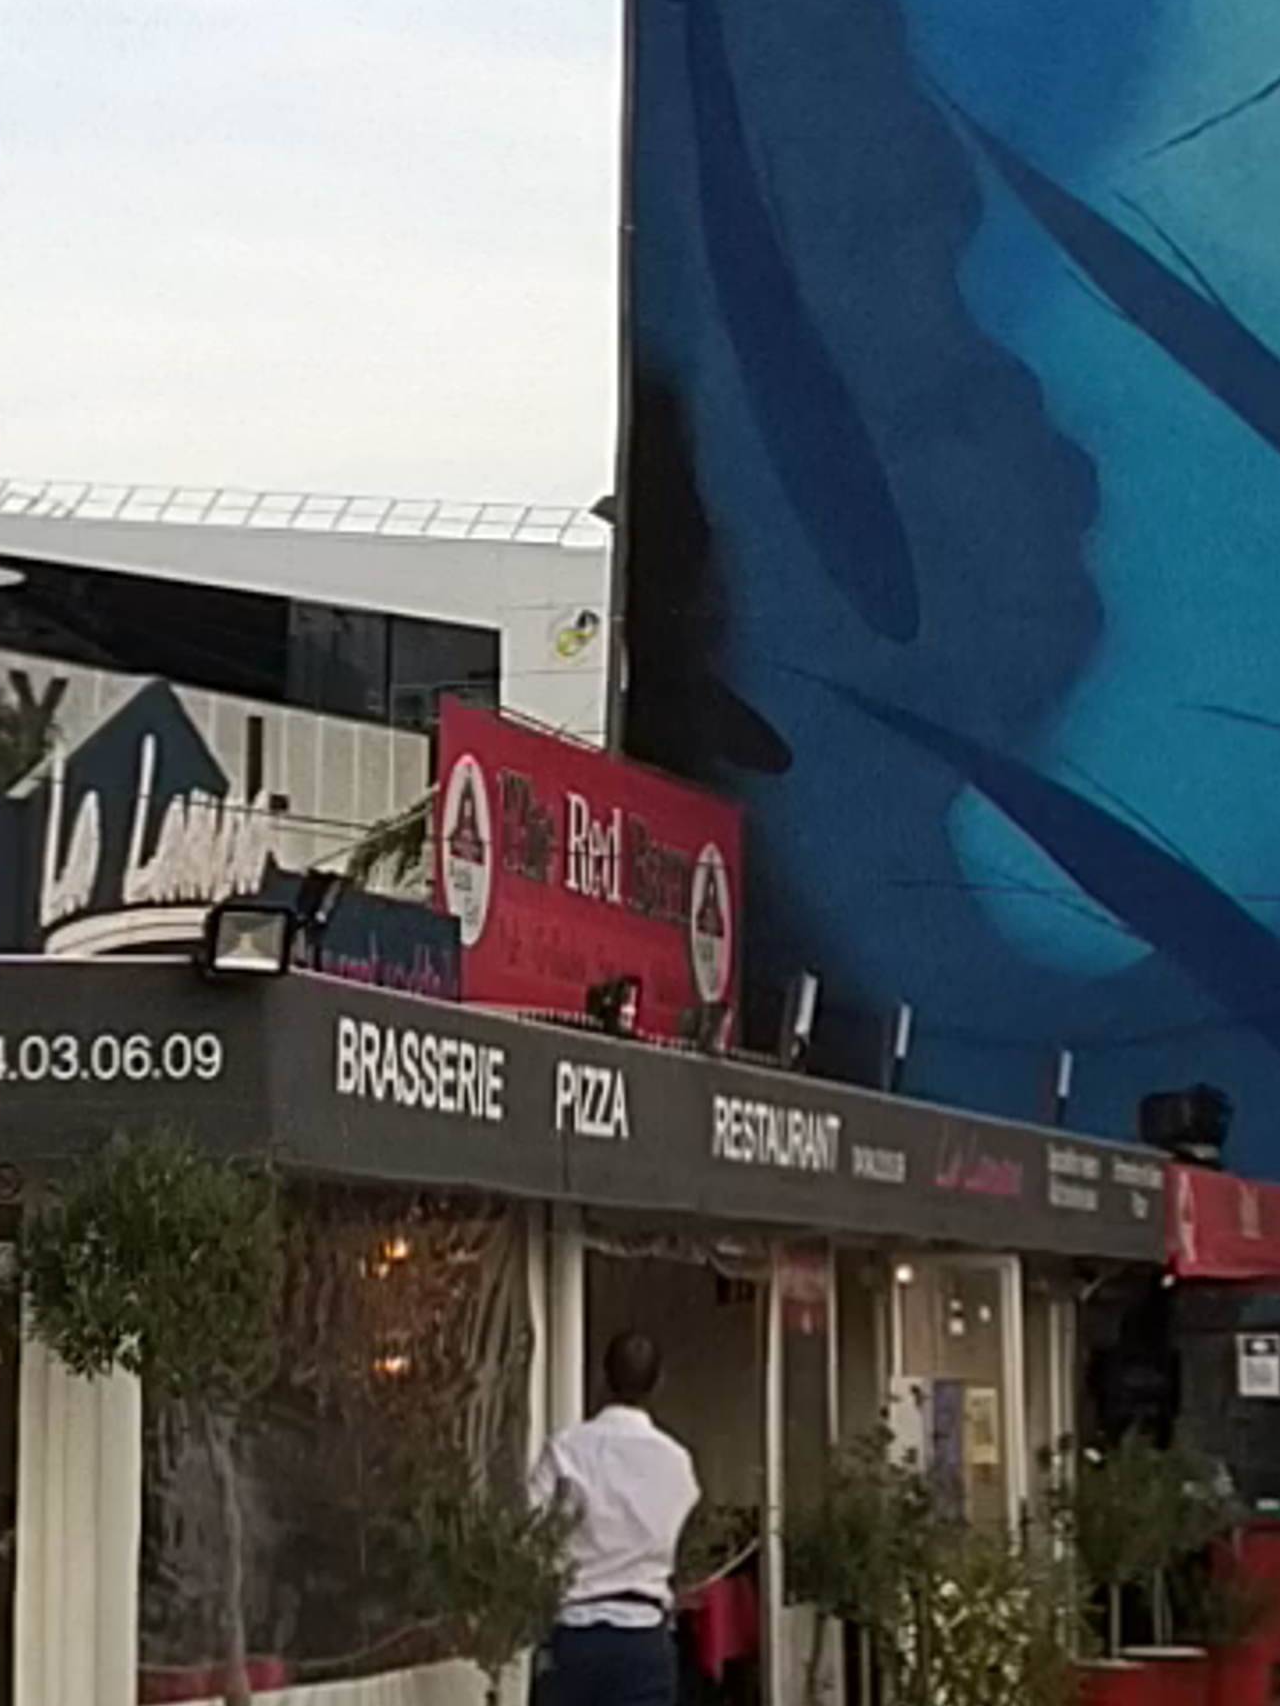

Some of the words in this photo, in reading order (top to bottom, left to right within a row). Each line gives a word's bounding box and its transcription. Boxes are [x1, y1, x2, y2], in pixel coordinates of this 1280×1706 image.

[566, 791, 622, 903] Red
[335, 1017, 505, 1120] BRASSERIE
[555, 1059, 629, 1139] PIZZA
[712, 1096, 841, 1172] RESTAURANT
